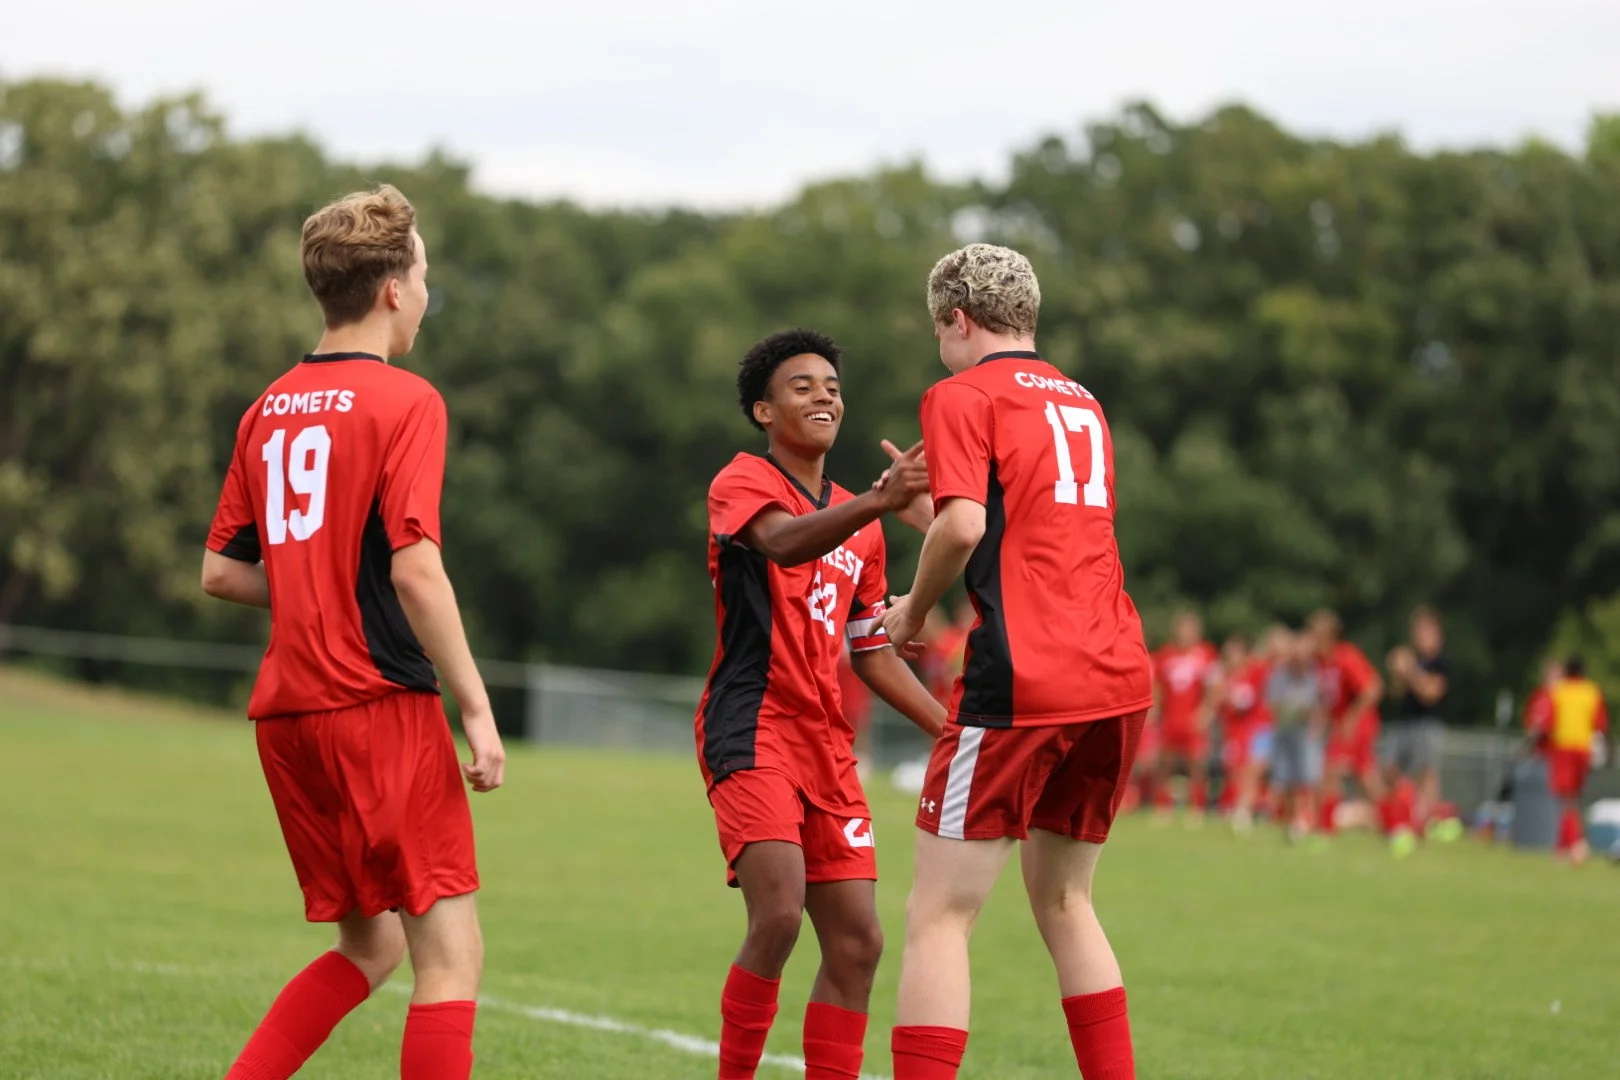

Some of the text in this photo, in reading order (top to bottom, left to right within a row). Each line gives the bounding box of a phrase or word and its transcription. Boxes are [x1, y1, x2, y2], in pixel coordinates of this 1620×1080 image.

[1014, 371, 1095, 400] COMETS
[262, 389, 356, 417] COMETS
[1044, 400, 1108, 508] 17
[262, 424, 332, 545] 19
[843, 817, 875, 848] 2
